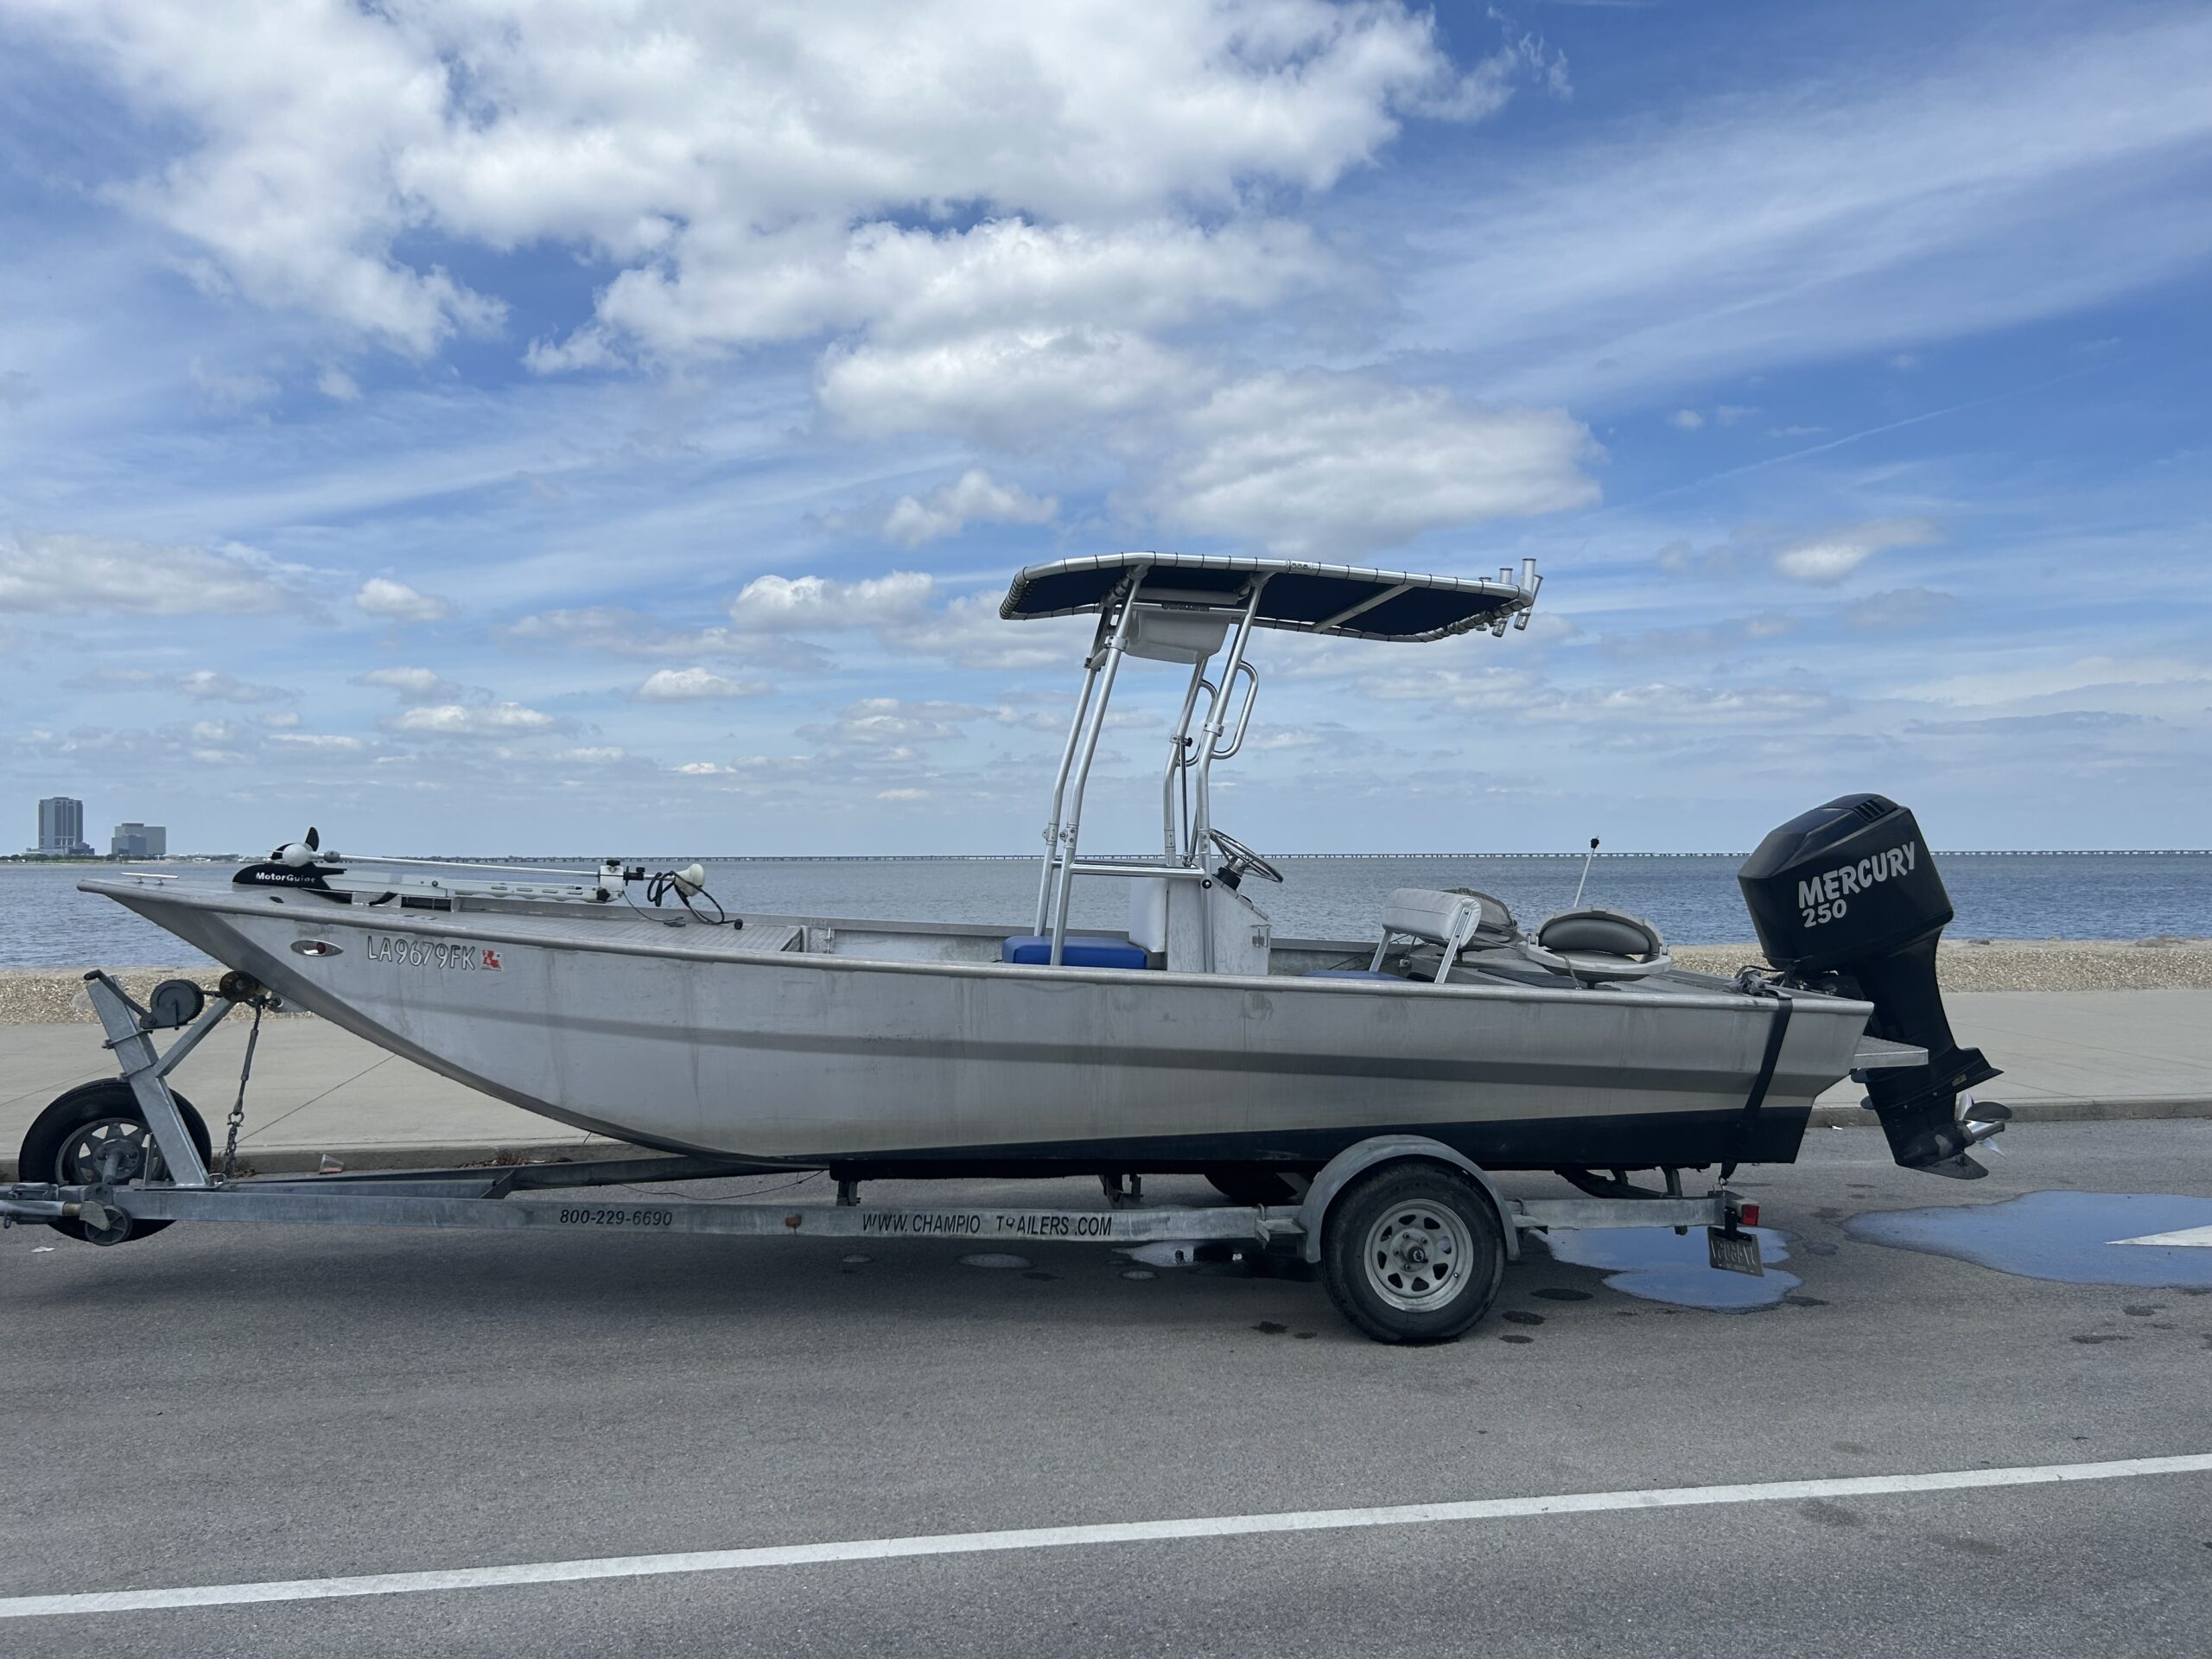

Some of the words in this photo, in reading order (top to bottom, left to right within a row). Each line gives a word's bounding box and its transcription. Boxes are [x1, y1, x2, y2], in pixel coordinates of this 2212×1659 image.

[1798, 841, 1916, 909] MERCURY
[1802, 899, 1847, 928] 250
[560, 1209, 673, 1226] 800-229-6690
